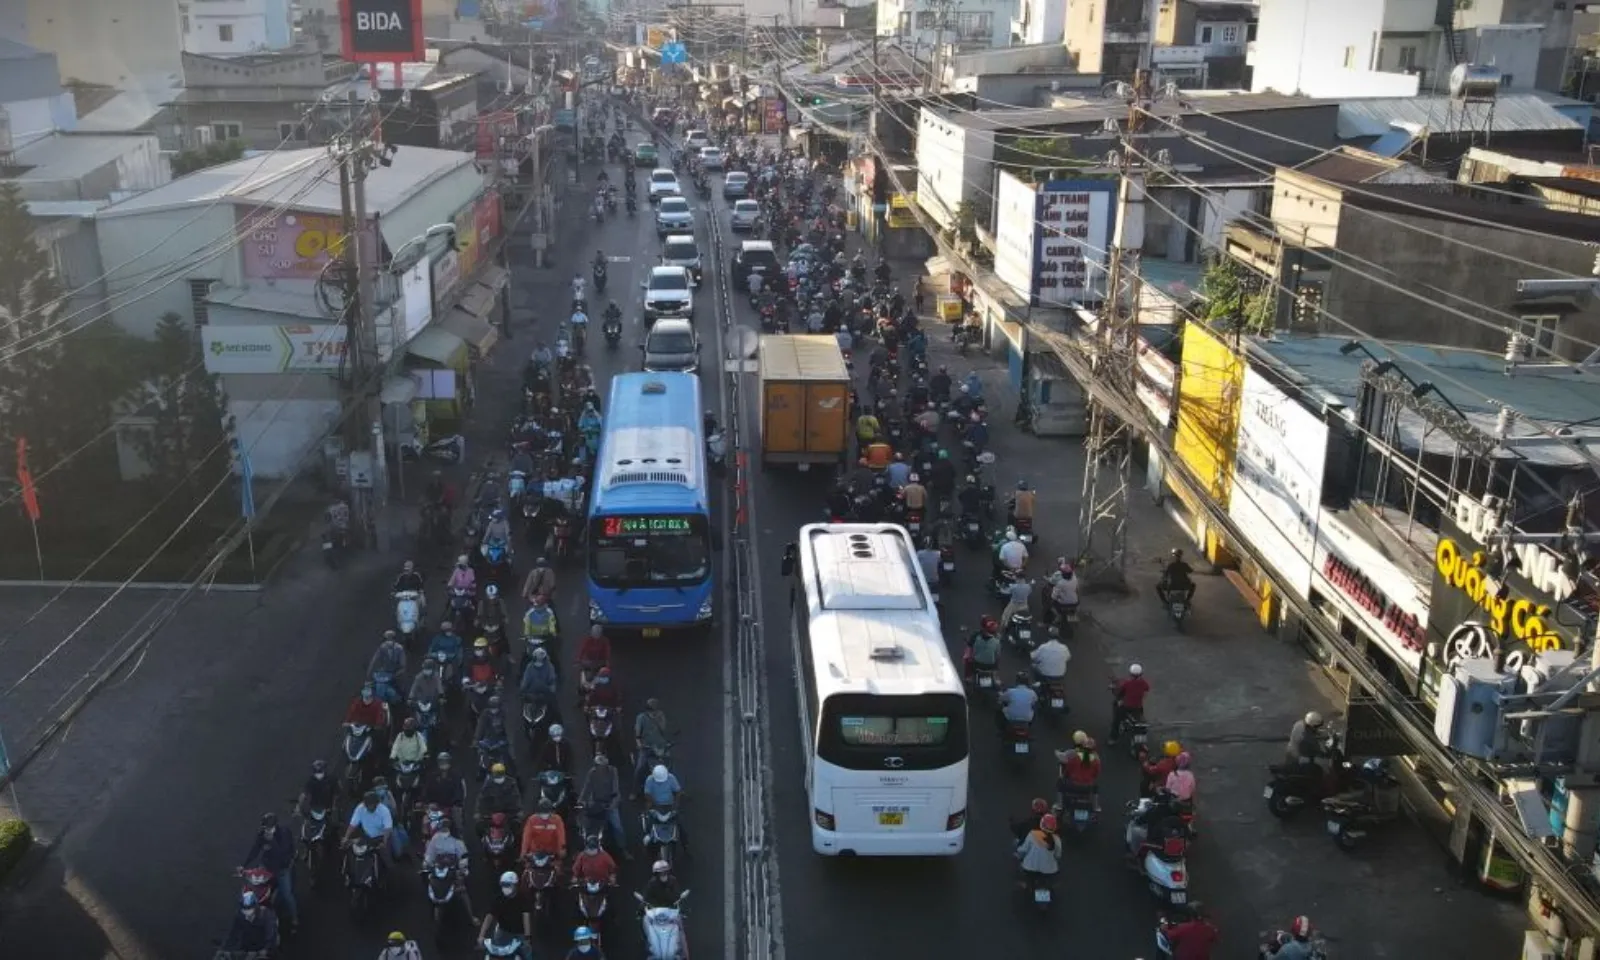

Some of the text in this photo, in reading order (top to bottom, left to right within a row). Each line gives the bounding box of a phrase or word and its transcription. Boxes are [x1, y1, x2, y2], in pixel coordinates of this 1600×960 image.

[357, 11, 402, 30] BIDA
[1060, 193, 1090, 204] THANH
[1046, 246, 1082, 257] CAMERA
[225, 344, 272, 352] MEKONG
[1436, 538, 1506, 638] Quảng
